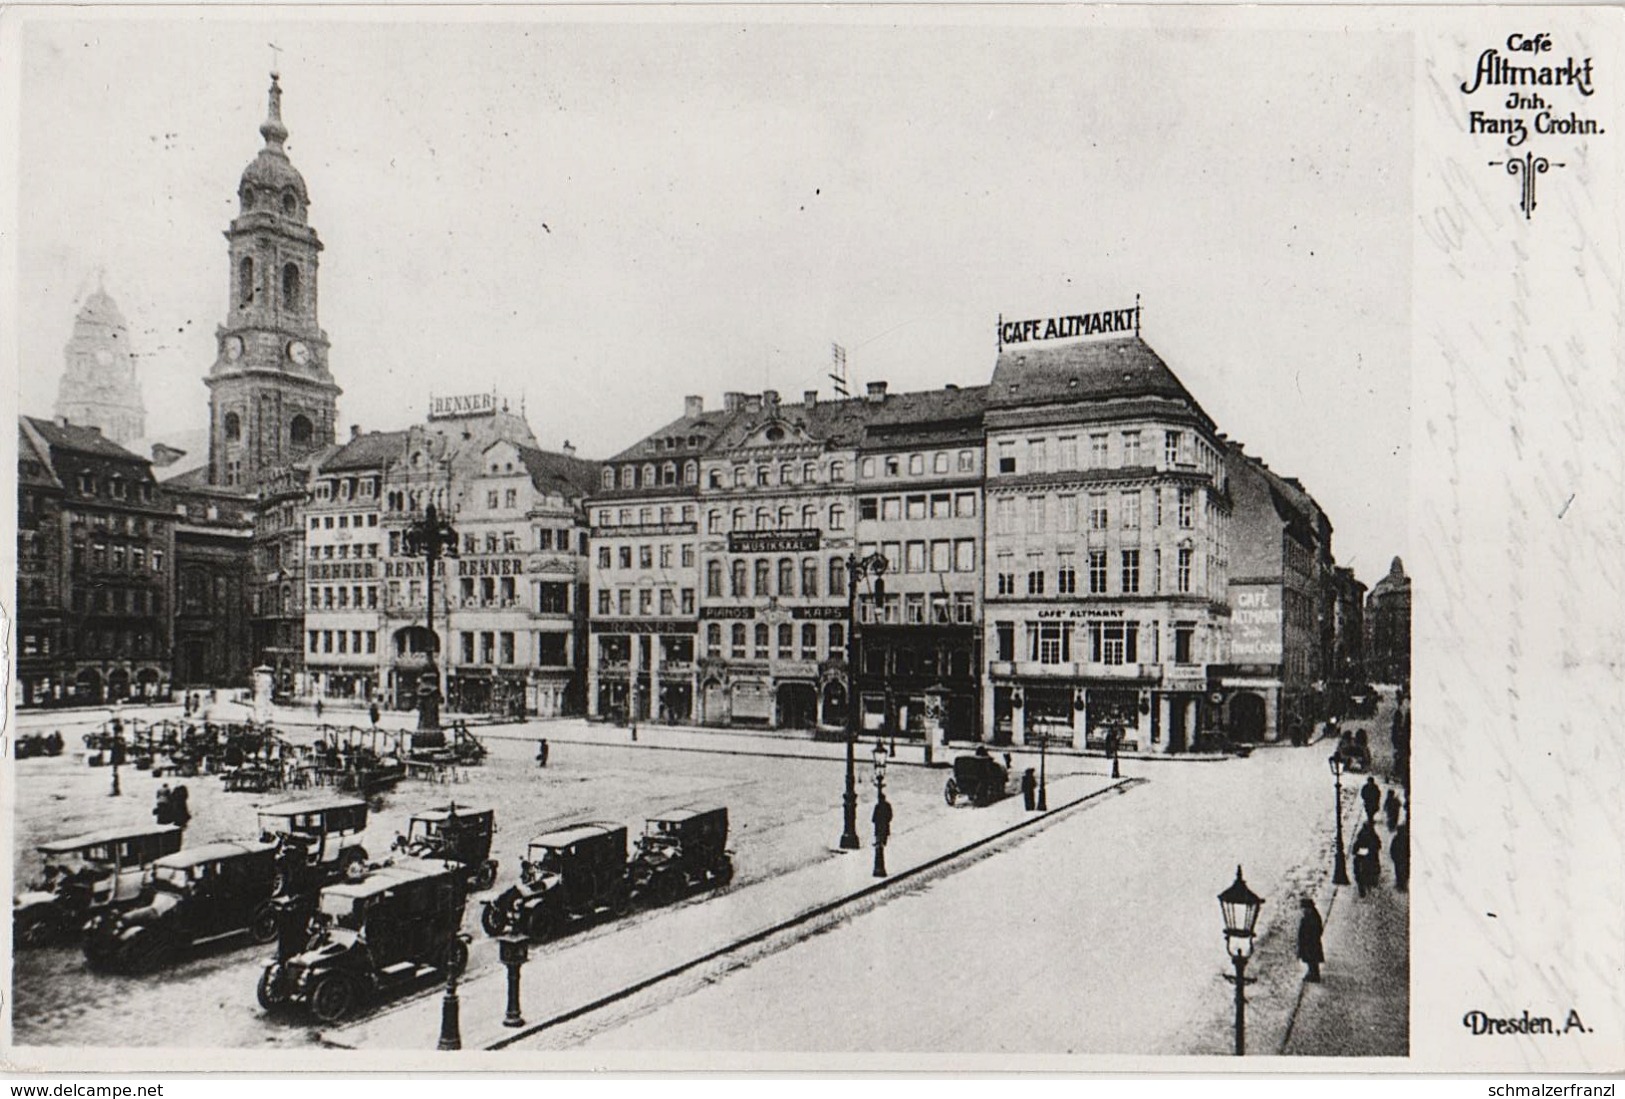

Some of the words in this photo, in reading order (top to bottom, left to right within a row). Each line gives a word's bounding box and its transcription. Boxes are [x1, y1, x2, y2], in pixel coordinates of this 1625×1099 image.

[1043, 307, 1136, 340] ALTMARKT
[434, 393, 491, 413] RENNER
[741, 539, 807, 552] MUSIKSAAL
[309, 562, 374, 580] RENNER
[384, 561, 446, 578] RENNR
[458, 560, 523, 576] RENNER
[705, 608, 750, 620] PIANOS
[803, 607, 843, 619] KAPS
[1069, 610, 1125, 618] ALTMARKT
[610, 622, 677, 634] RENNER
